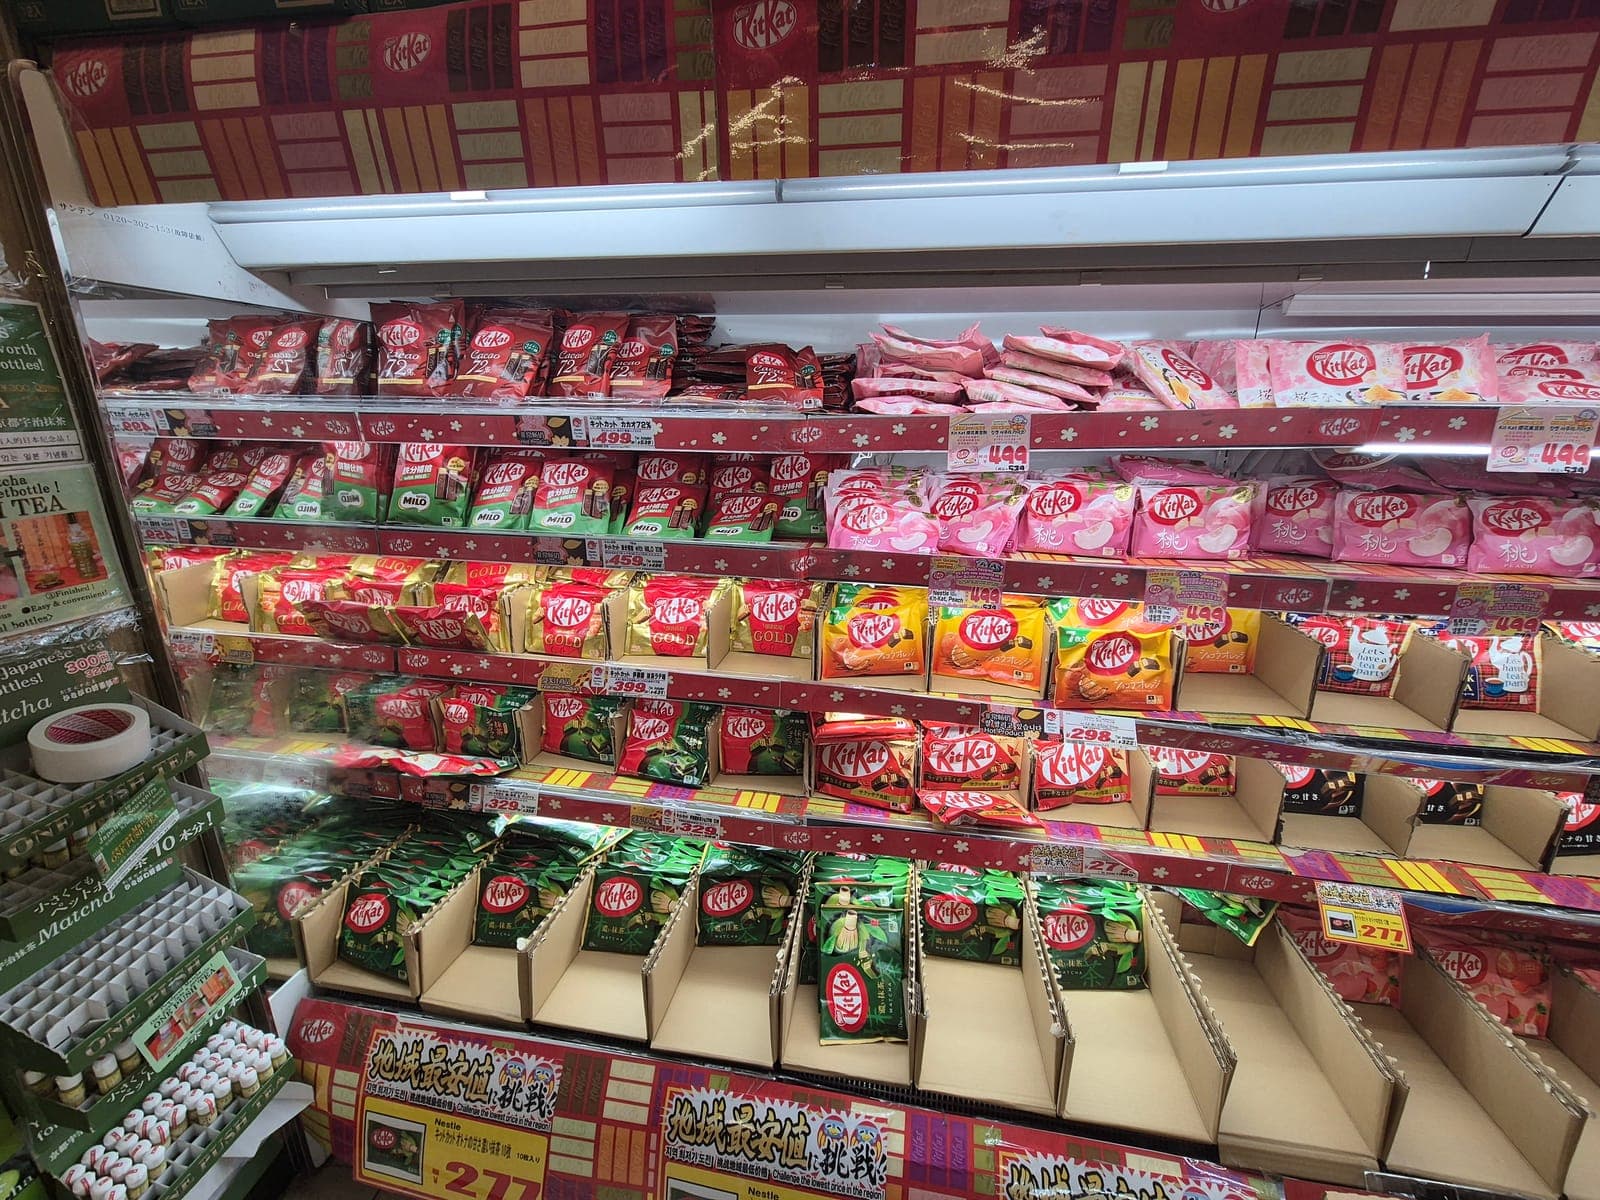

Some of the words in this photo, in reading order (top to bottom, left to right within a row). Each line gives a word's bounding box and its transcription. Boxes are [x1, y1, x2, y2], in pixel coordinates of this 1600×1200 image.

[734, 2, 796, 48] KitKat
[384, 33, 432, 72] KitKat
[65, 61, 108, 96] KitKat
[382, 325, 419, 346] KitKat
[475, 328, 510, 347] KitKat
[562, 328, 591, 348] KitKat
[1320, 352, 1366, 378] KitKat
[1322, 418, 1360, 436] KitKat
[596, 431, 632, 444] 499
[988, 445, 1028, 465] 499
[1541, 442, 1590, 465] 499
[488, 464, 524, 483] KitKat
[549, 465, 588, 486] KitKat
[642, 459, 677, 479] KitKat
[715, 467, 750, 488] KitKat
[774, 457, 809, 479] KitKat
[11, 494, 67, 514] TEA
[402, 496, 427, 506] MILO
[722, 496, 761, 514] KitKat
[940, 499, 973, 516] KitKat
[1035, 491, 1073, 515] KitKat
[1158, 495, 1195, 519] KitKat
[1273, 489, 1316, 508] KitKat
[1359, 496, 1406, 519] KitKat
[477, 512, 500, 521] MILO
[546, 515, 571, 524] MILO
[850, 508, 888, 529] KitKat
[1491, 507, 1540, 530] KitKat
[632, 523, 658, 533] MILO
[609, 555, 643, 566] 459
[469, 565, 507, 578] GOLD
[970, 586, 1001, 604] 499
[551, 600, 591, 626] KitKat
[659, 596, 698, 624] KitKat
[756, 593, 797, 622] KitKat
[1186, 605, 1224, 622] 499
[856, 616, 894, 641] KitKat
[971, 617, 1011, 644] KitKat
[1495, 616, 1539, 632] 499
[544, 632, 582, 649] GOLD
[652, 632, 695, 647] GOLD
[753, 630, 794, 645] GOLD
[1, 649, 74, 680] Japanese
[1096, 641, 1133, 670] KitKat
[1359, 661, 1375, 670] tea
[613, 681, 647, 693] 399
[552, 699, 582, 718] KitKat
[635, 718, 669, 740] KitKat
[730, 718, 766, 737] KitKat
[1071, 728, 1112, 742] 298
[827, 741, 885, 777] KitKat
[932, 738, 995, 772] KitKat
[488, 798, 519, 811] 329
[680, 822, 718, 836] 329
[1241, 875, 1274, 889] KitKat
[490, 882, 522, 907] KitKat
[601, 884, 638, 911] KitKat
[711, 885, 749, 911] KitKat
[932, 902, 972, 923] KitKat
[1051, 914, 1087, 943] KitKat
[1360, 924, 1404, 942] 277
[833, 971, 861, 1020] KitKat
[302, 1020, 336, 1043] KitKat
[434, 1117, 462, 1131] Nestle
